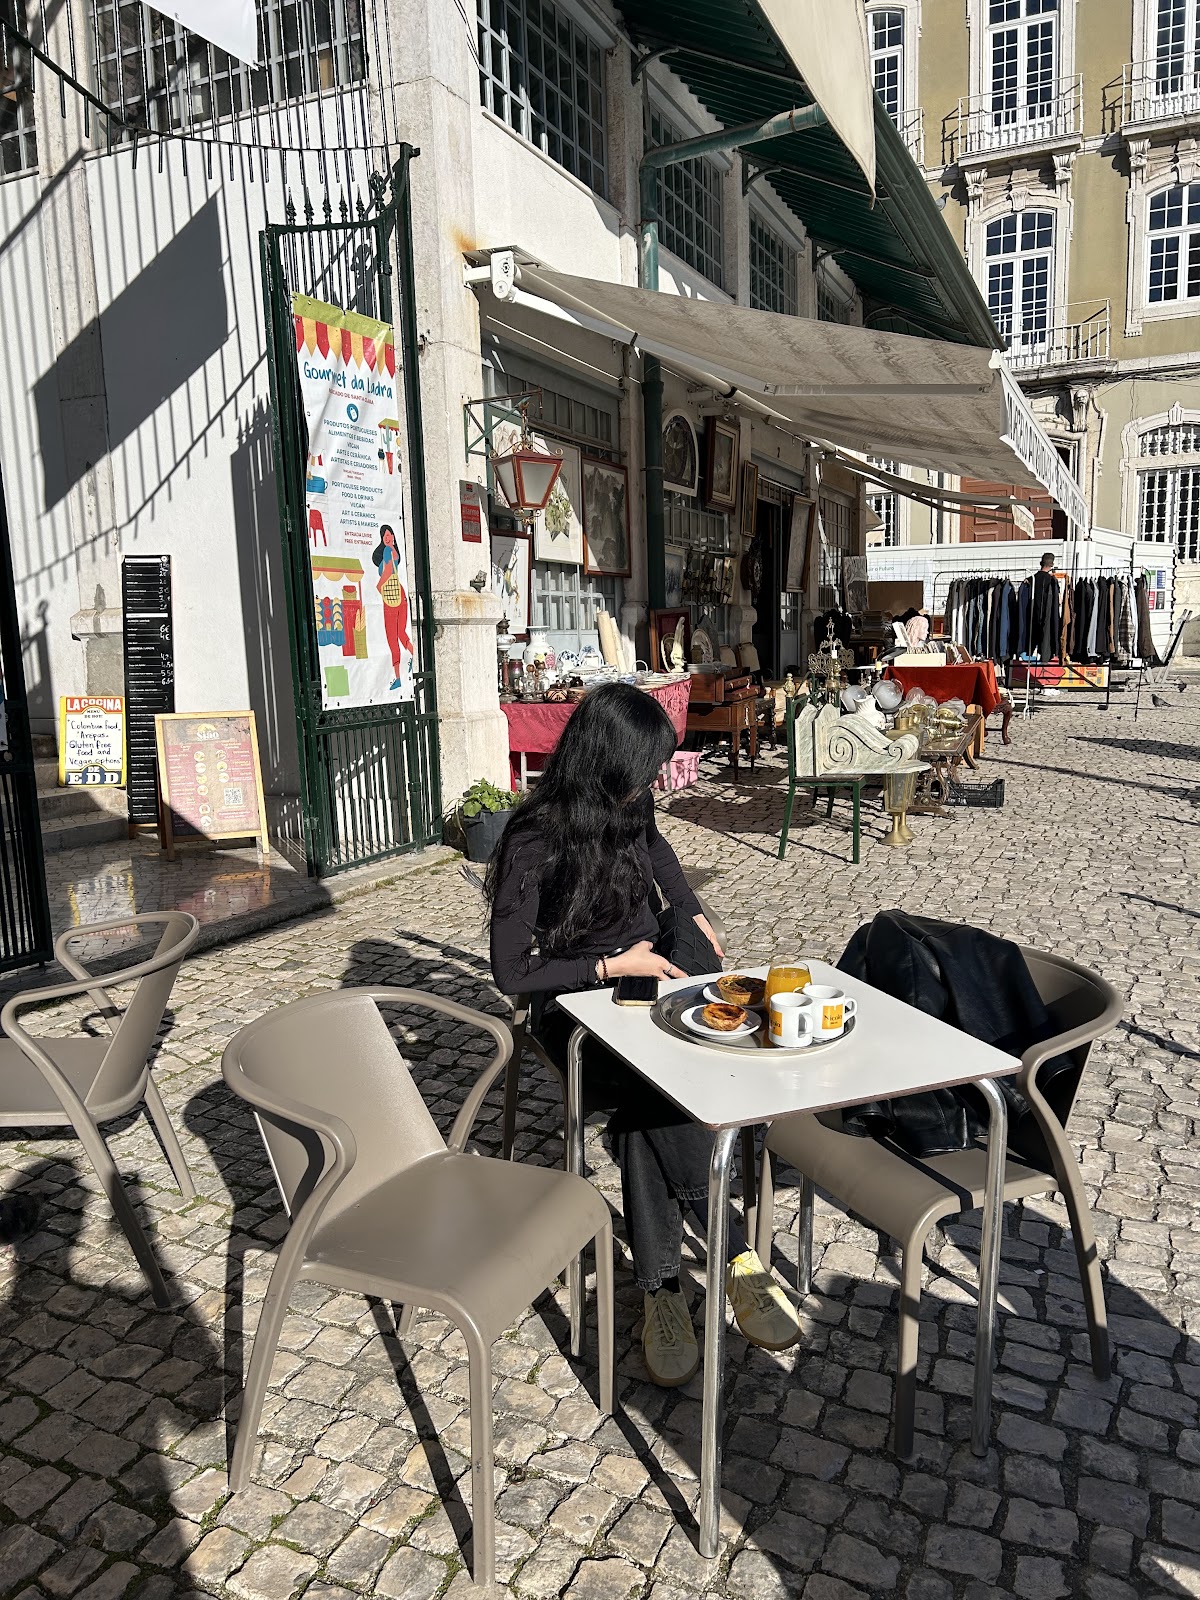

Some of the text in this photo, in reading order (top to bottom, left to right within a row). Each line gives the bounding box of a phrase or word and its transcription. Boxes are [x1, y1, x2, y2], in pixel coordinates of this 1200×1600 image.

[304, 361, 392, 399] Gourmet da Ladra
[324, 419, 377, 436] PRODUTOS PORTUGUESES
[328, 430, 353, 439] ALIMENTOS
[356, 435, 374, 444] BEBIDAS
[350, 451, 371, 460] CERÂMICA
[331, 457, 349, 465] ARTISTAS
[353, 461, 378, 470] CRIADORES
[332, 481, 359, 490] PORTUGUESE
[67, 699, 121, 710] LA COCINA
[69, 758, 92, 766] Vegan
